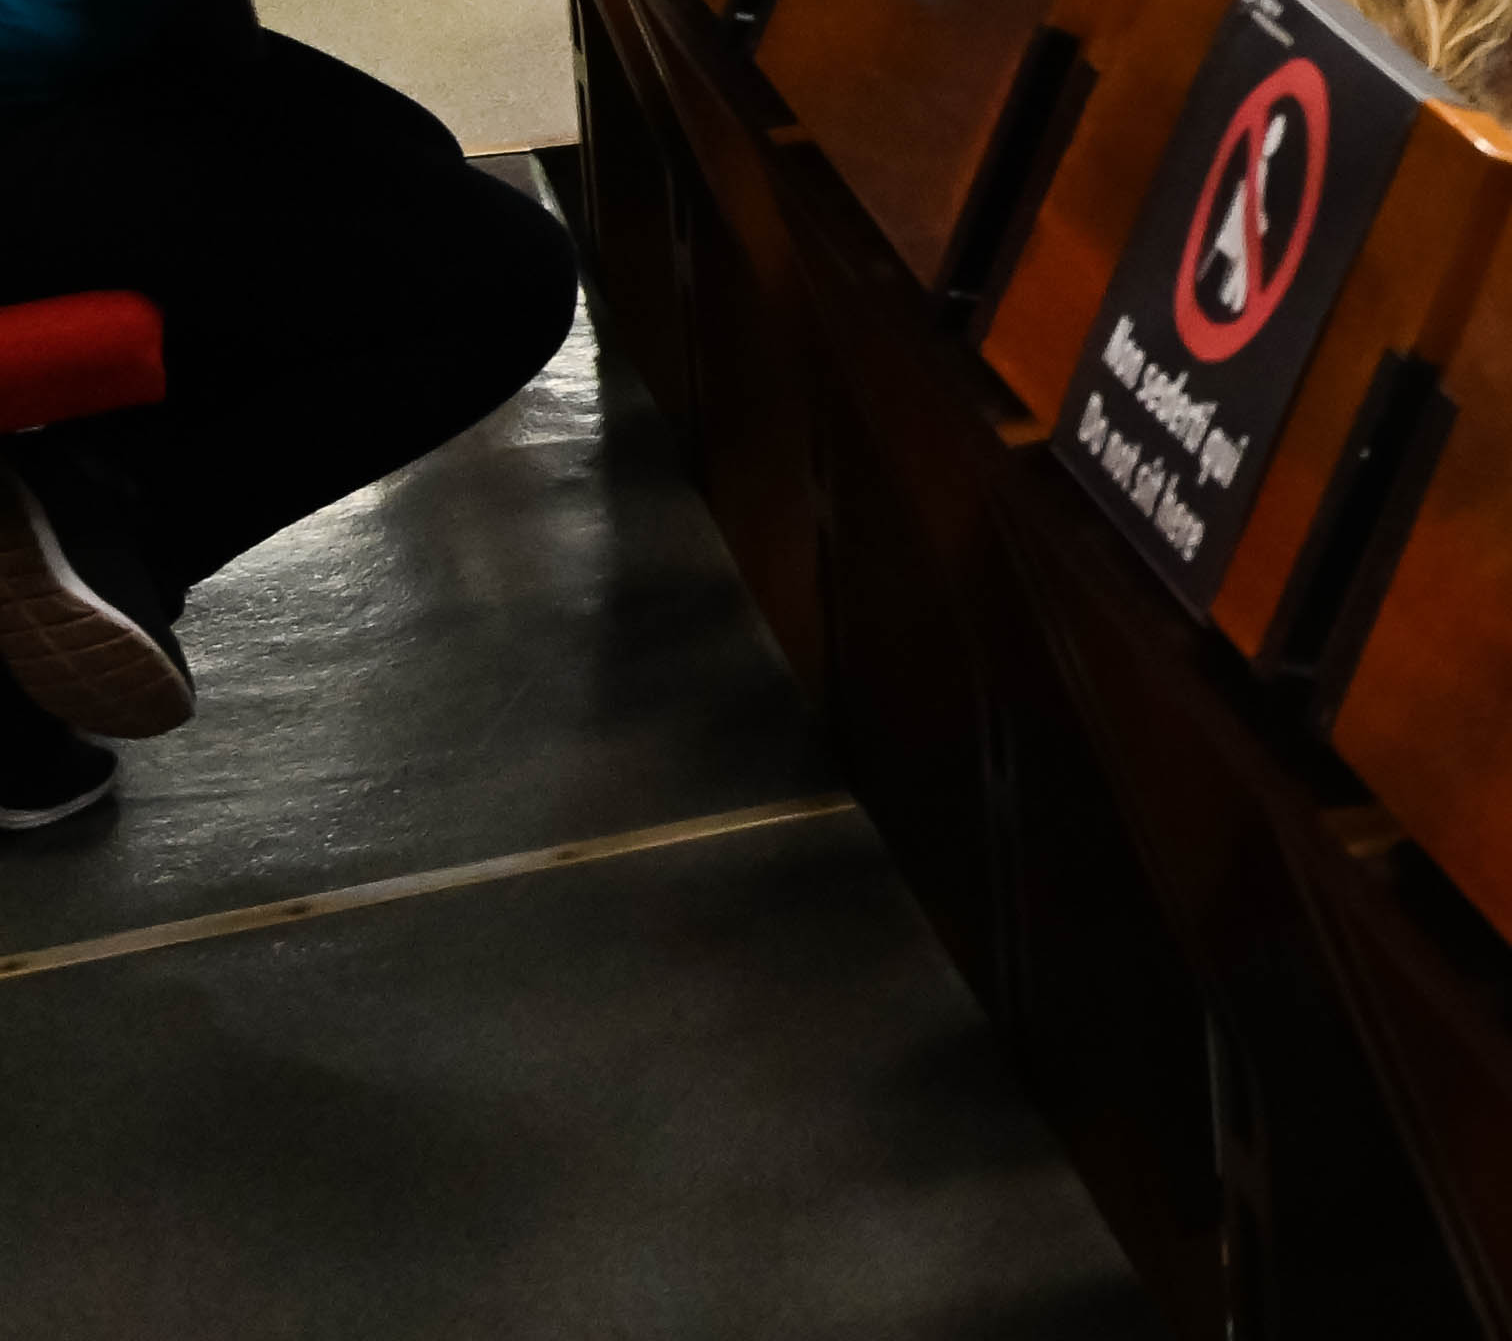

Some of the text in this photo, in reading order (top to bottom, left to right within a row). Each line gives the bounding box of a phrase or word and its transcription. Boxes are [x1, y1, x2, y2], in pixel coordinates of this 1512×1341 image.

[1080, 393, 1205, 561] Do not sit here
[1103, 315, 1250, 488] Non sederti qui
